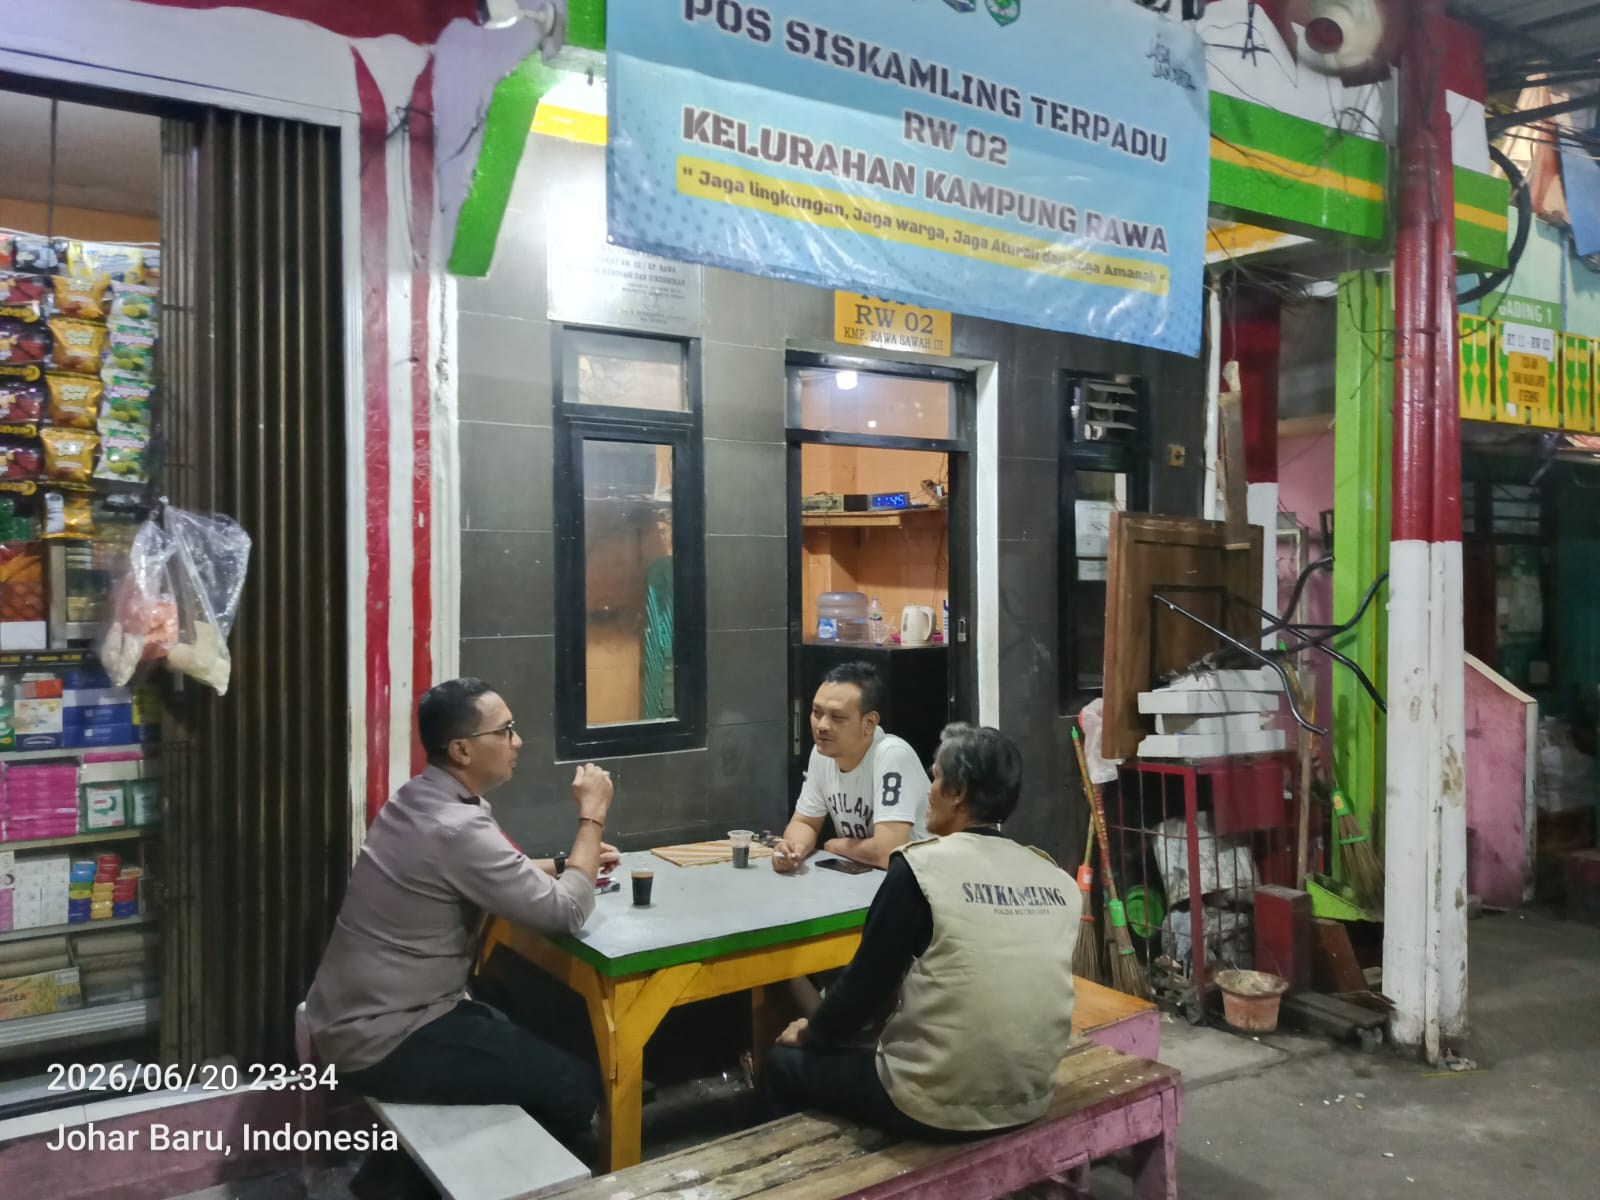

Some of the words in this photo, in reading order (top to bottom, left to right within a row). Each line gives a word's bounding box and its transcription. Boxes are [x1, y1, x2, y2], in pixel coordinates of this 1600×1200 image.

[684, 0, 772, 43] POS
[786, 20, 1021, 118] SISKAMLING
[1030, 95, 1168, 163] TERPADU
[904, 111, 957, 151] RW
[966, 129, 1008, 165] 02
[683, 106, 915, 195] KELURAHAN
[926, 170, 1077, 234] KAMPUNG
[1086, 211, 1168, 254] RAWA
[698, 171, 745, 194] Jaga
[750, 181, 849, 220] lingkungan,
[853, 207, 892, 229] Jaga
[895, 217, 950, 244] warga,
[953, 229, 988, 250] Jaga
[844, 326, 869, 341] KMP.
[855, 303, 896, 329] RW
[904, 311, 934, 335] 02
[881, 772, 902, 807] 8
